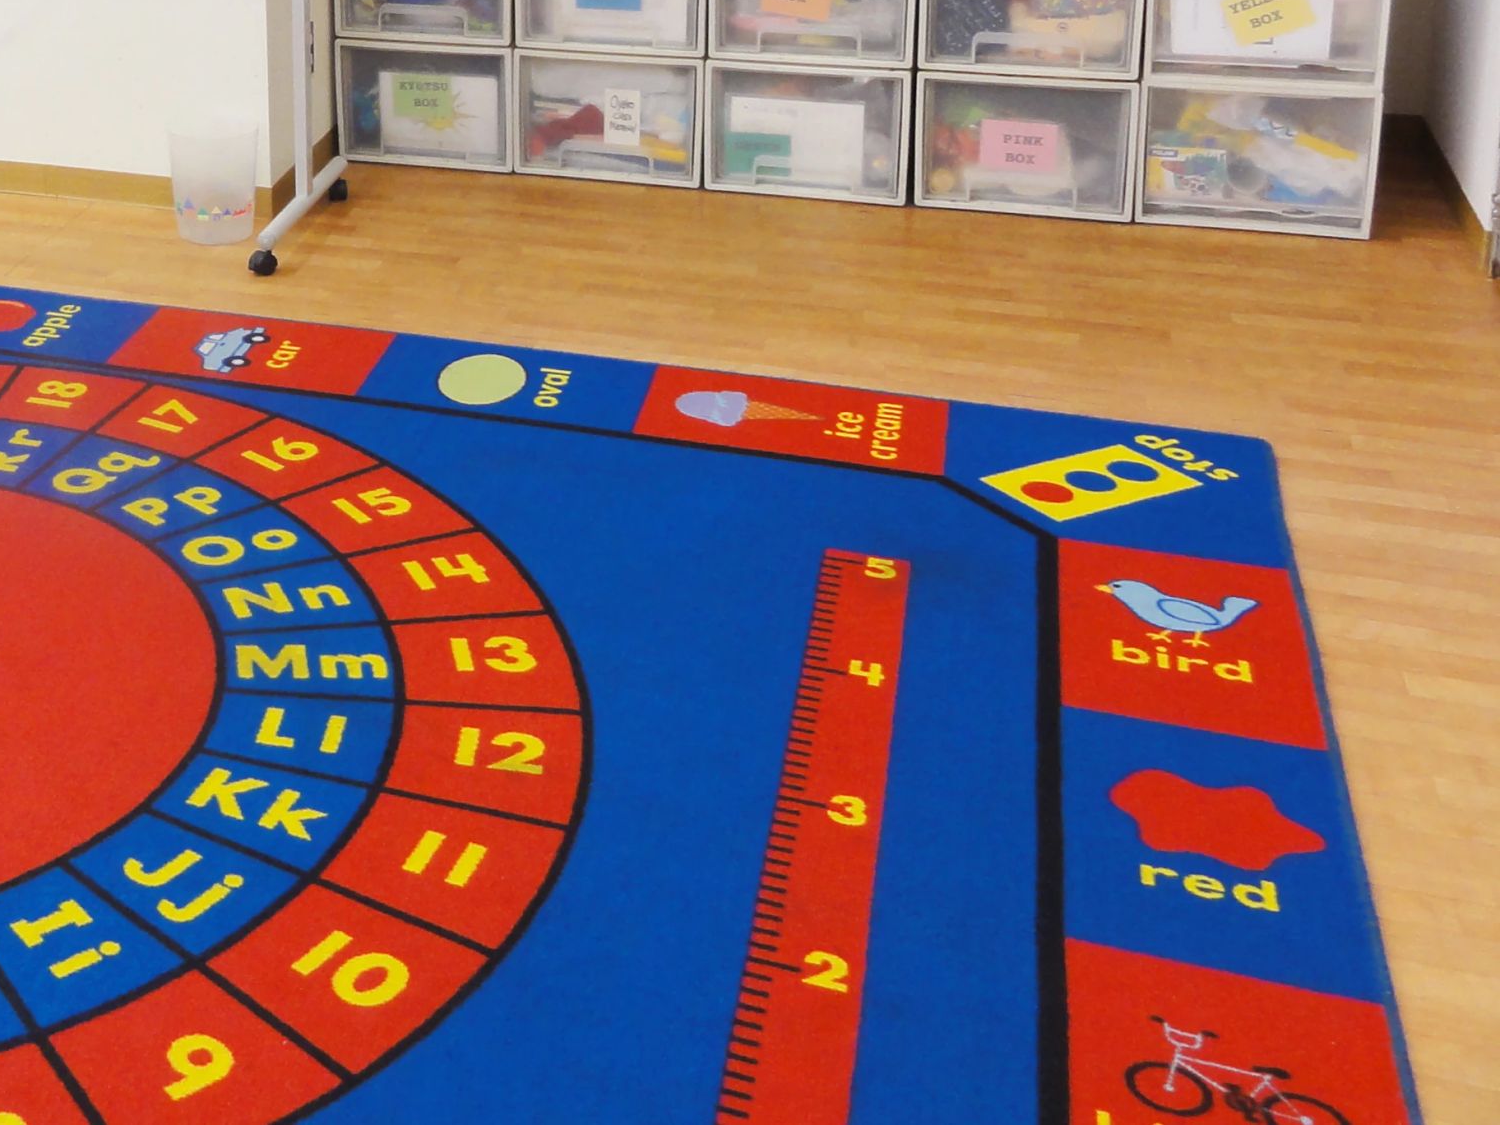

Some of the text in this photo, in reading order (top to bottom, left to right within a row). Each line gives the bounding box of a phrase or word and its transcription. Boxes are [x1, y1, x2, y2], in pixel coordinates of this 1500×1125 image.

[1248, 9, 1284, 29] BOX
[412, 98, 439, 108] BOX
[1002, 133, 1044, 147] PINK
[1004, 152, 1036, 165] BOX
[21, 302, 82, 348] apple
[265, 340, 301, 369] car
[25, 380, 88, 409] 18
[532, 366, 572, 408] oval
[137, 399, 198, 434] 17
[823, 411, 865, 439] ice
[870, 402, 903, 460] cream
[241, 436, 319, 472] 16
[1134, 432, 1241, 483] stop
[332, 487, 412, 524] 15
[402, 553, 490, 591] 14
[864, 557, 897, 579] 5
[450, 635, 538, 673] 13
[1111, 637, 1253, 683] bird
[848, 659, 885, 687] 4
[454, 726, 546, 775] 12
[827, 795, 868, 827] 3
[402, 830, 488, 888] 11
[1140, 865, 1279, 911] red
[291, 930, 410, 1007] 10
[802, 951, 849, 993] 2
[163, 1034, 235, 1101] 9
